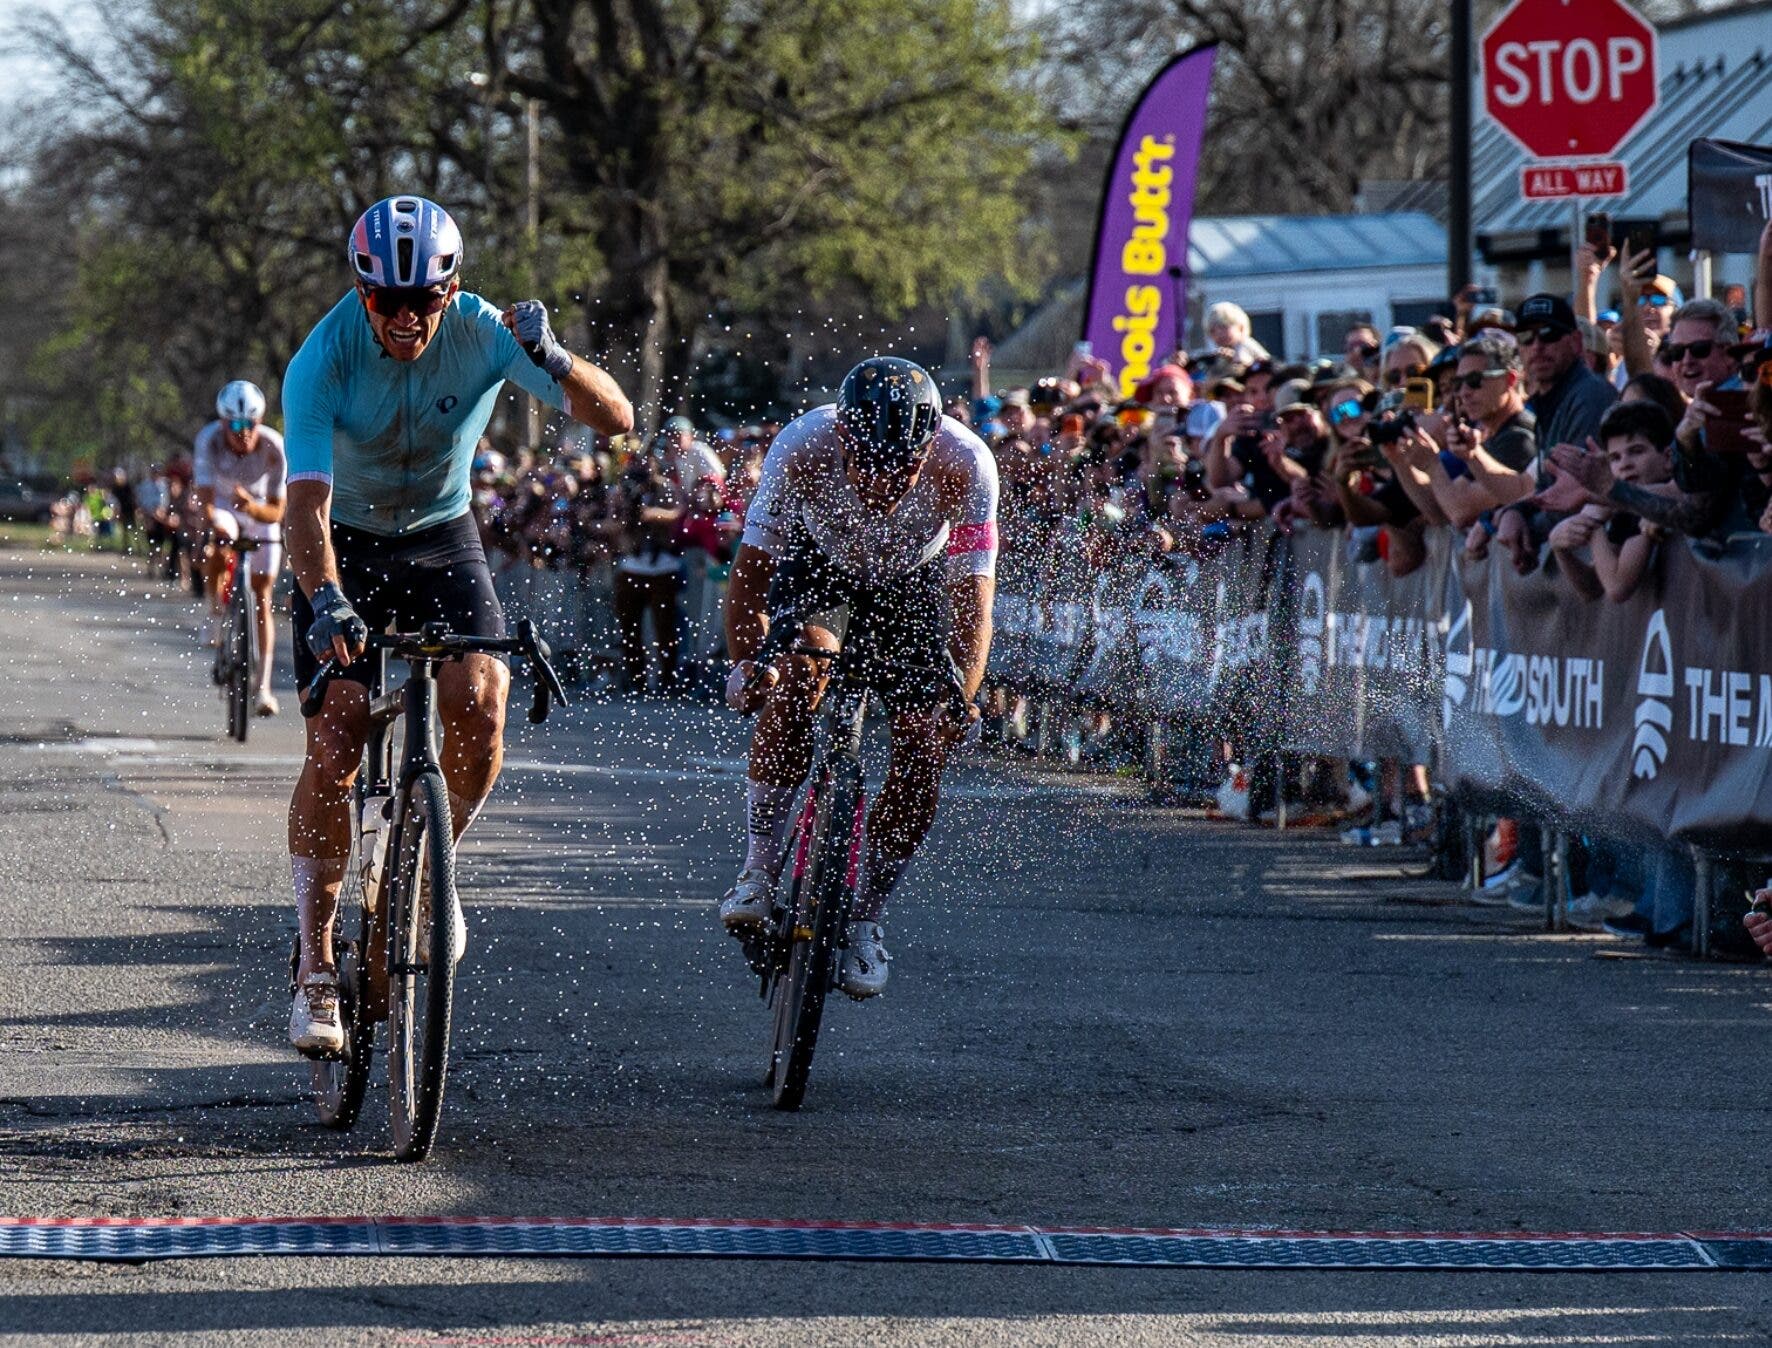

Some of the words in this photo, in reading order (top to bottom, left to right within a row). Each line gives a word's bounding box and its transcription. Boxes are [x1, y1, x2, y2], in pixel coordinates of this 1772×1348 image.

[1494, 37, 1645, 107] STOP
[1530, 171, 1570, 194] ALL
[1575, 168, 1618, 192] WAY
[1685, 667, 1751, 746] THE
